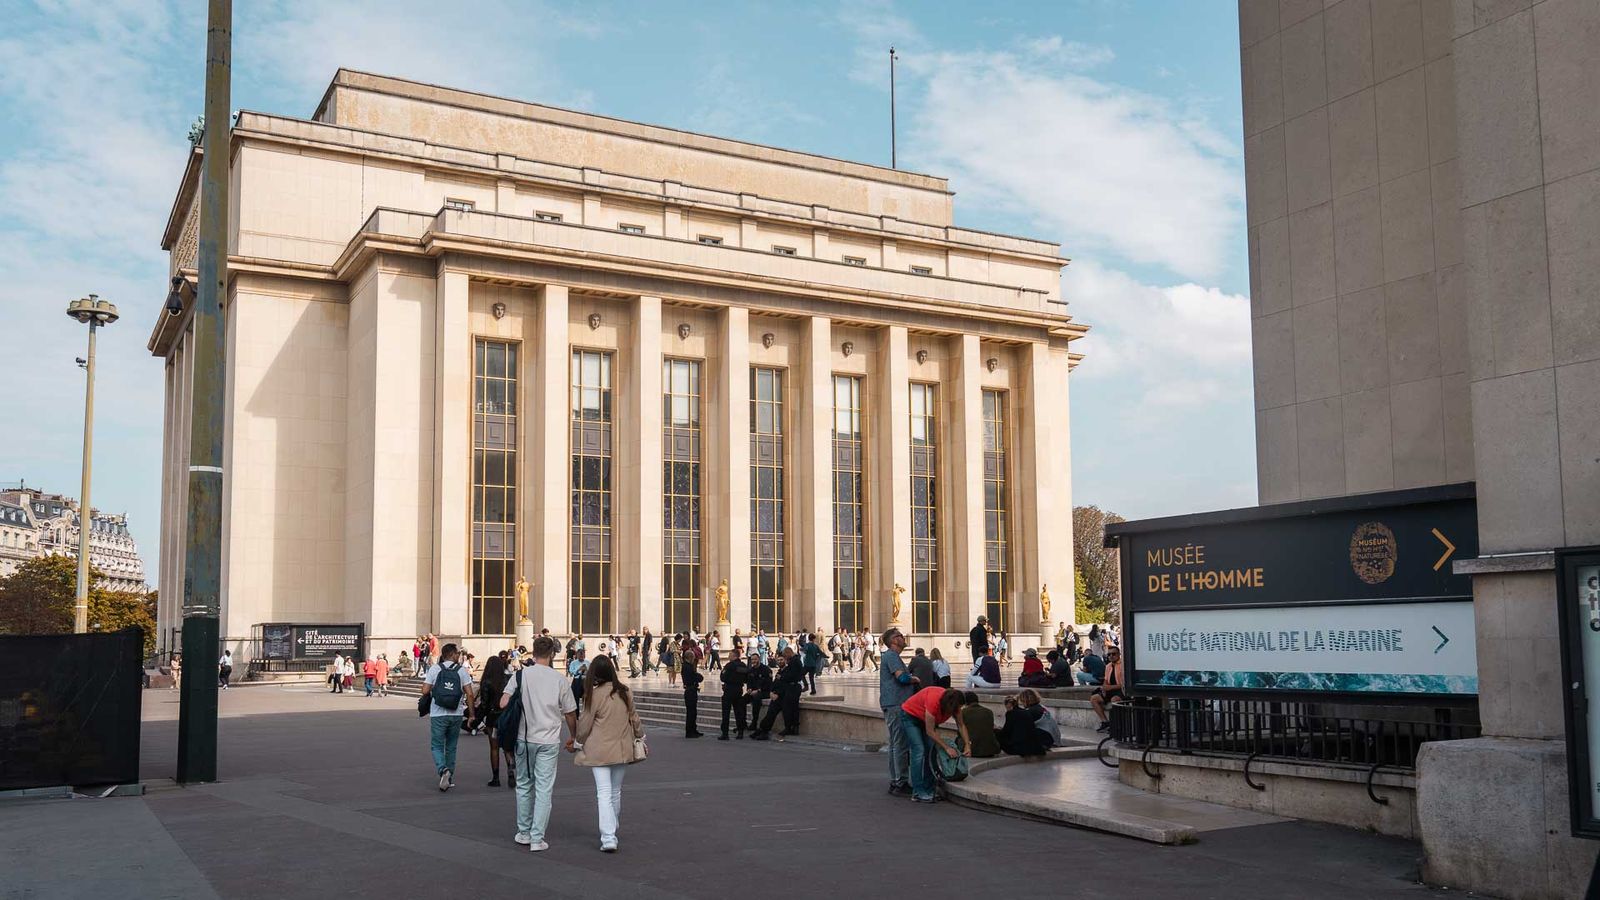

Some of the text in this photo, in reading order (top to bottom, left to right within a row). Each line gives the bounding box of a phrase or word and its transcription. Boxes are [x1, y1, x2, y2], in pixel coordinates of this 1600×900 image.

[1147, 543, 1205, 567] MUSÉE
[1148, 568, 1264, 593] DE L'HOMME
[1148, 628, 1403, 652] MUSÉE NATIONAL DE LA MARINE
